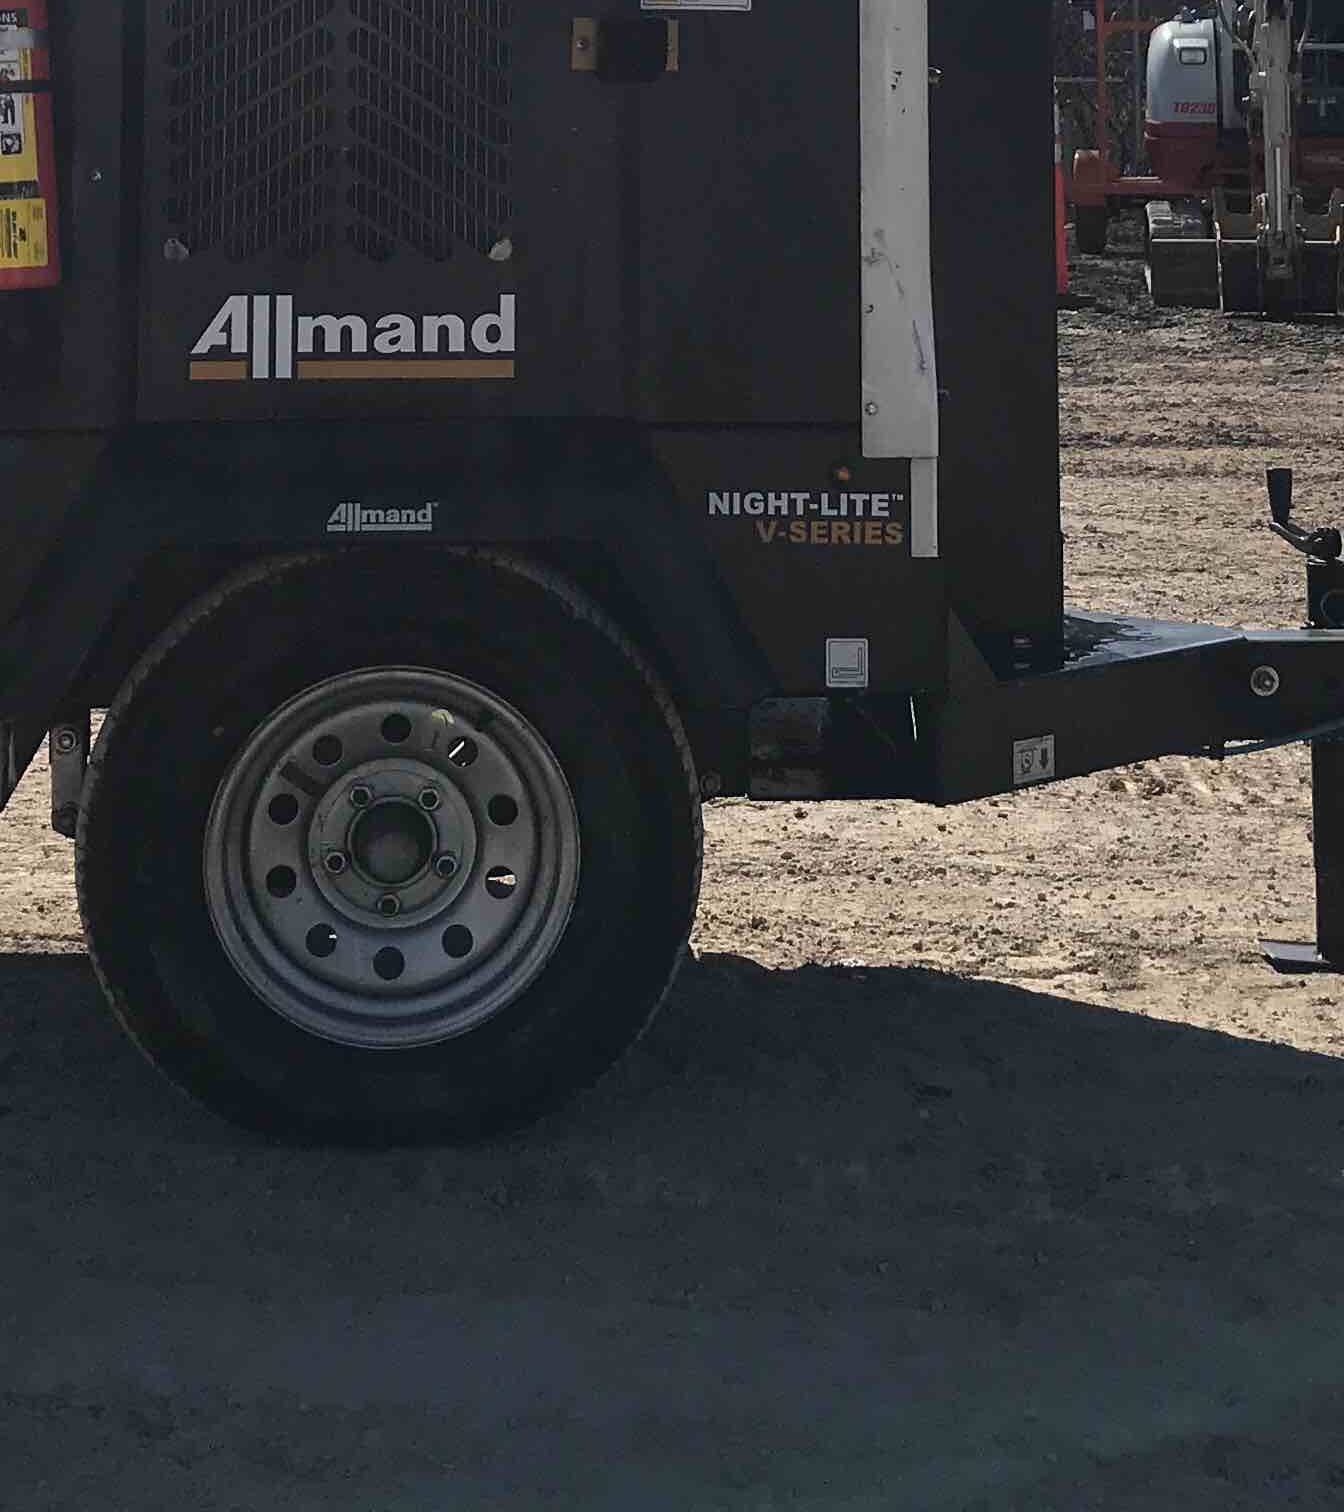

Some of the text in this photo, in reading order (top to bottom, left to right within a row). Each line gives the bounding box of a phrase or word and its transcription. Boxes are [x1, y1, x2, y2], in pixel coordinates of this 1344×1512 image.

[192, 294, 515, 379] Allmand
[328, 503, 433, 532] Allmand
[757, 520, 904, 544] V-SERIES
